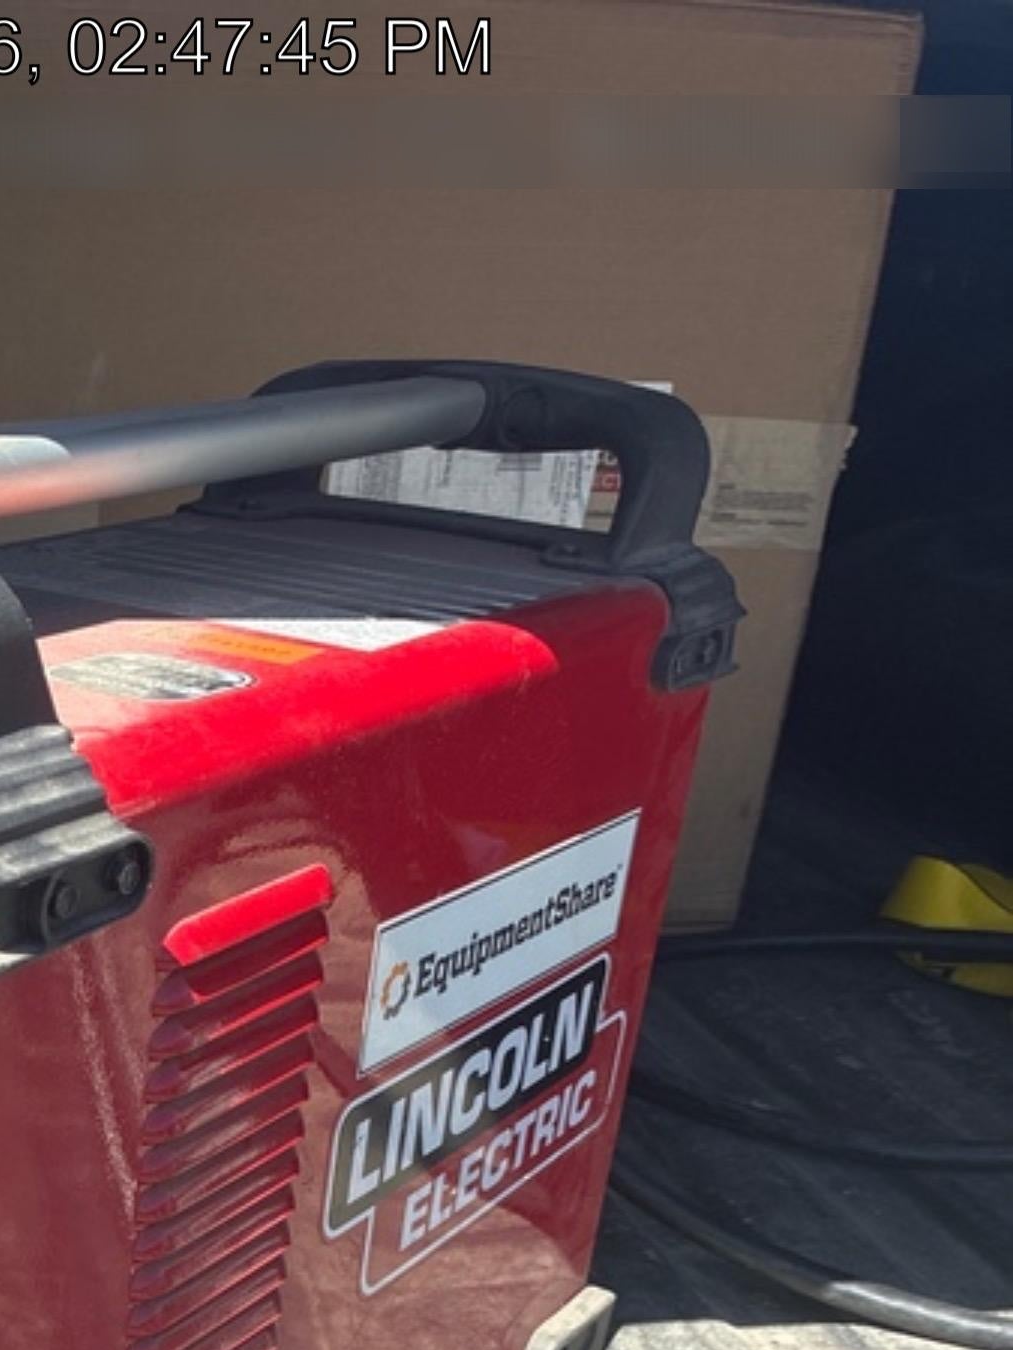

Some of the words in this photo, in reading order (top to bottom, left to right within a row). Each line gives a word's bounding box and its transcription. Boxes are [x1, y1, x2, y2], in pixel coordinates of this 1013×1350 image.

[414, 870, 617, 996] EquipmentShare
[346, 981, 594, 1204] LINCOLN
[399, 1069, 597, 1252] ELECTRIC
